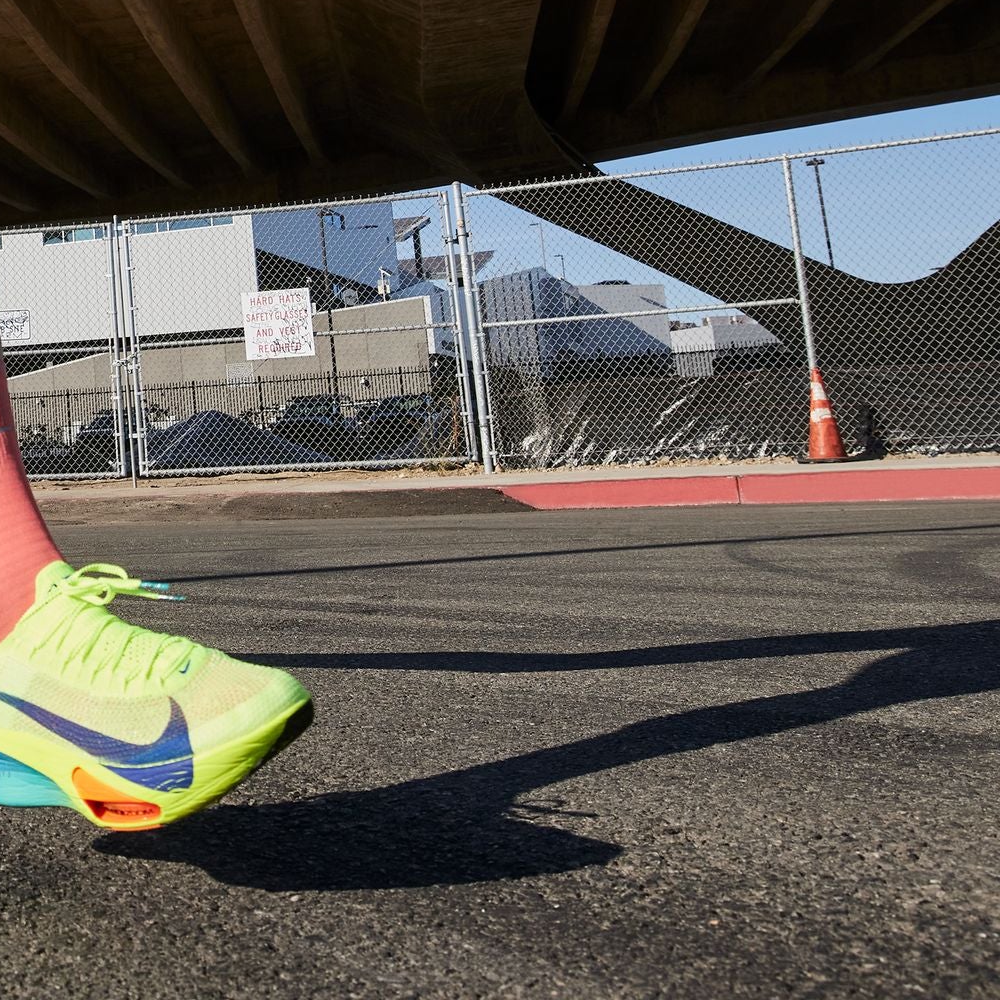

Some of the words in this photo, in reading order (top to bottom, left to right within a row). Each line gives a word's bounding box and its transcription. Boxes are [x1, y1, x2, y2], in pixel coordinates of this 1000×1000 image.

[249, 296, 274, 306] HARD
[279, 292, 301, 304] HATS
[246, 311, 273, 322] SAFETY
[275, 309, 309, 320] GLASSES
[256, 328, 274, 338] AND
[279, 325, 301, 337] VEST
[258, 341, 302, 353] REQUIRED
